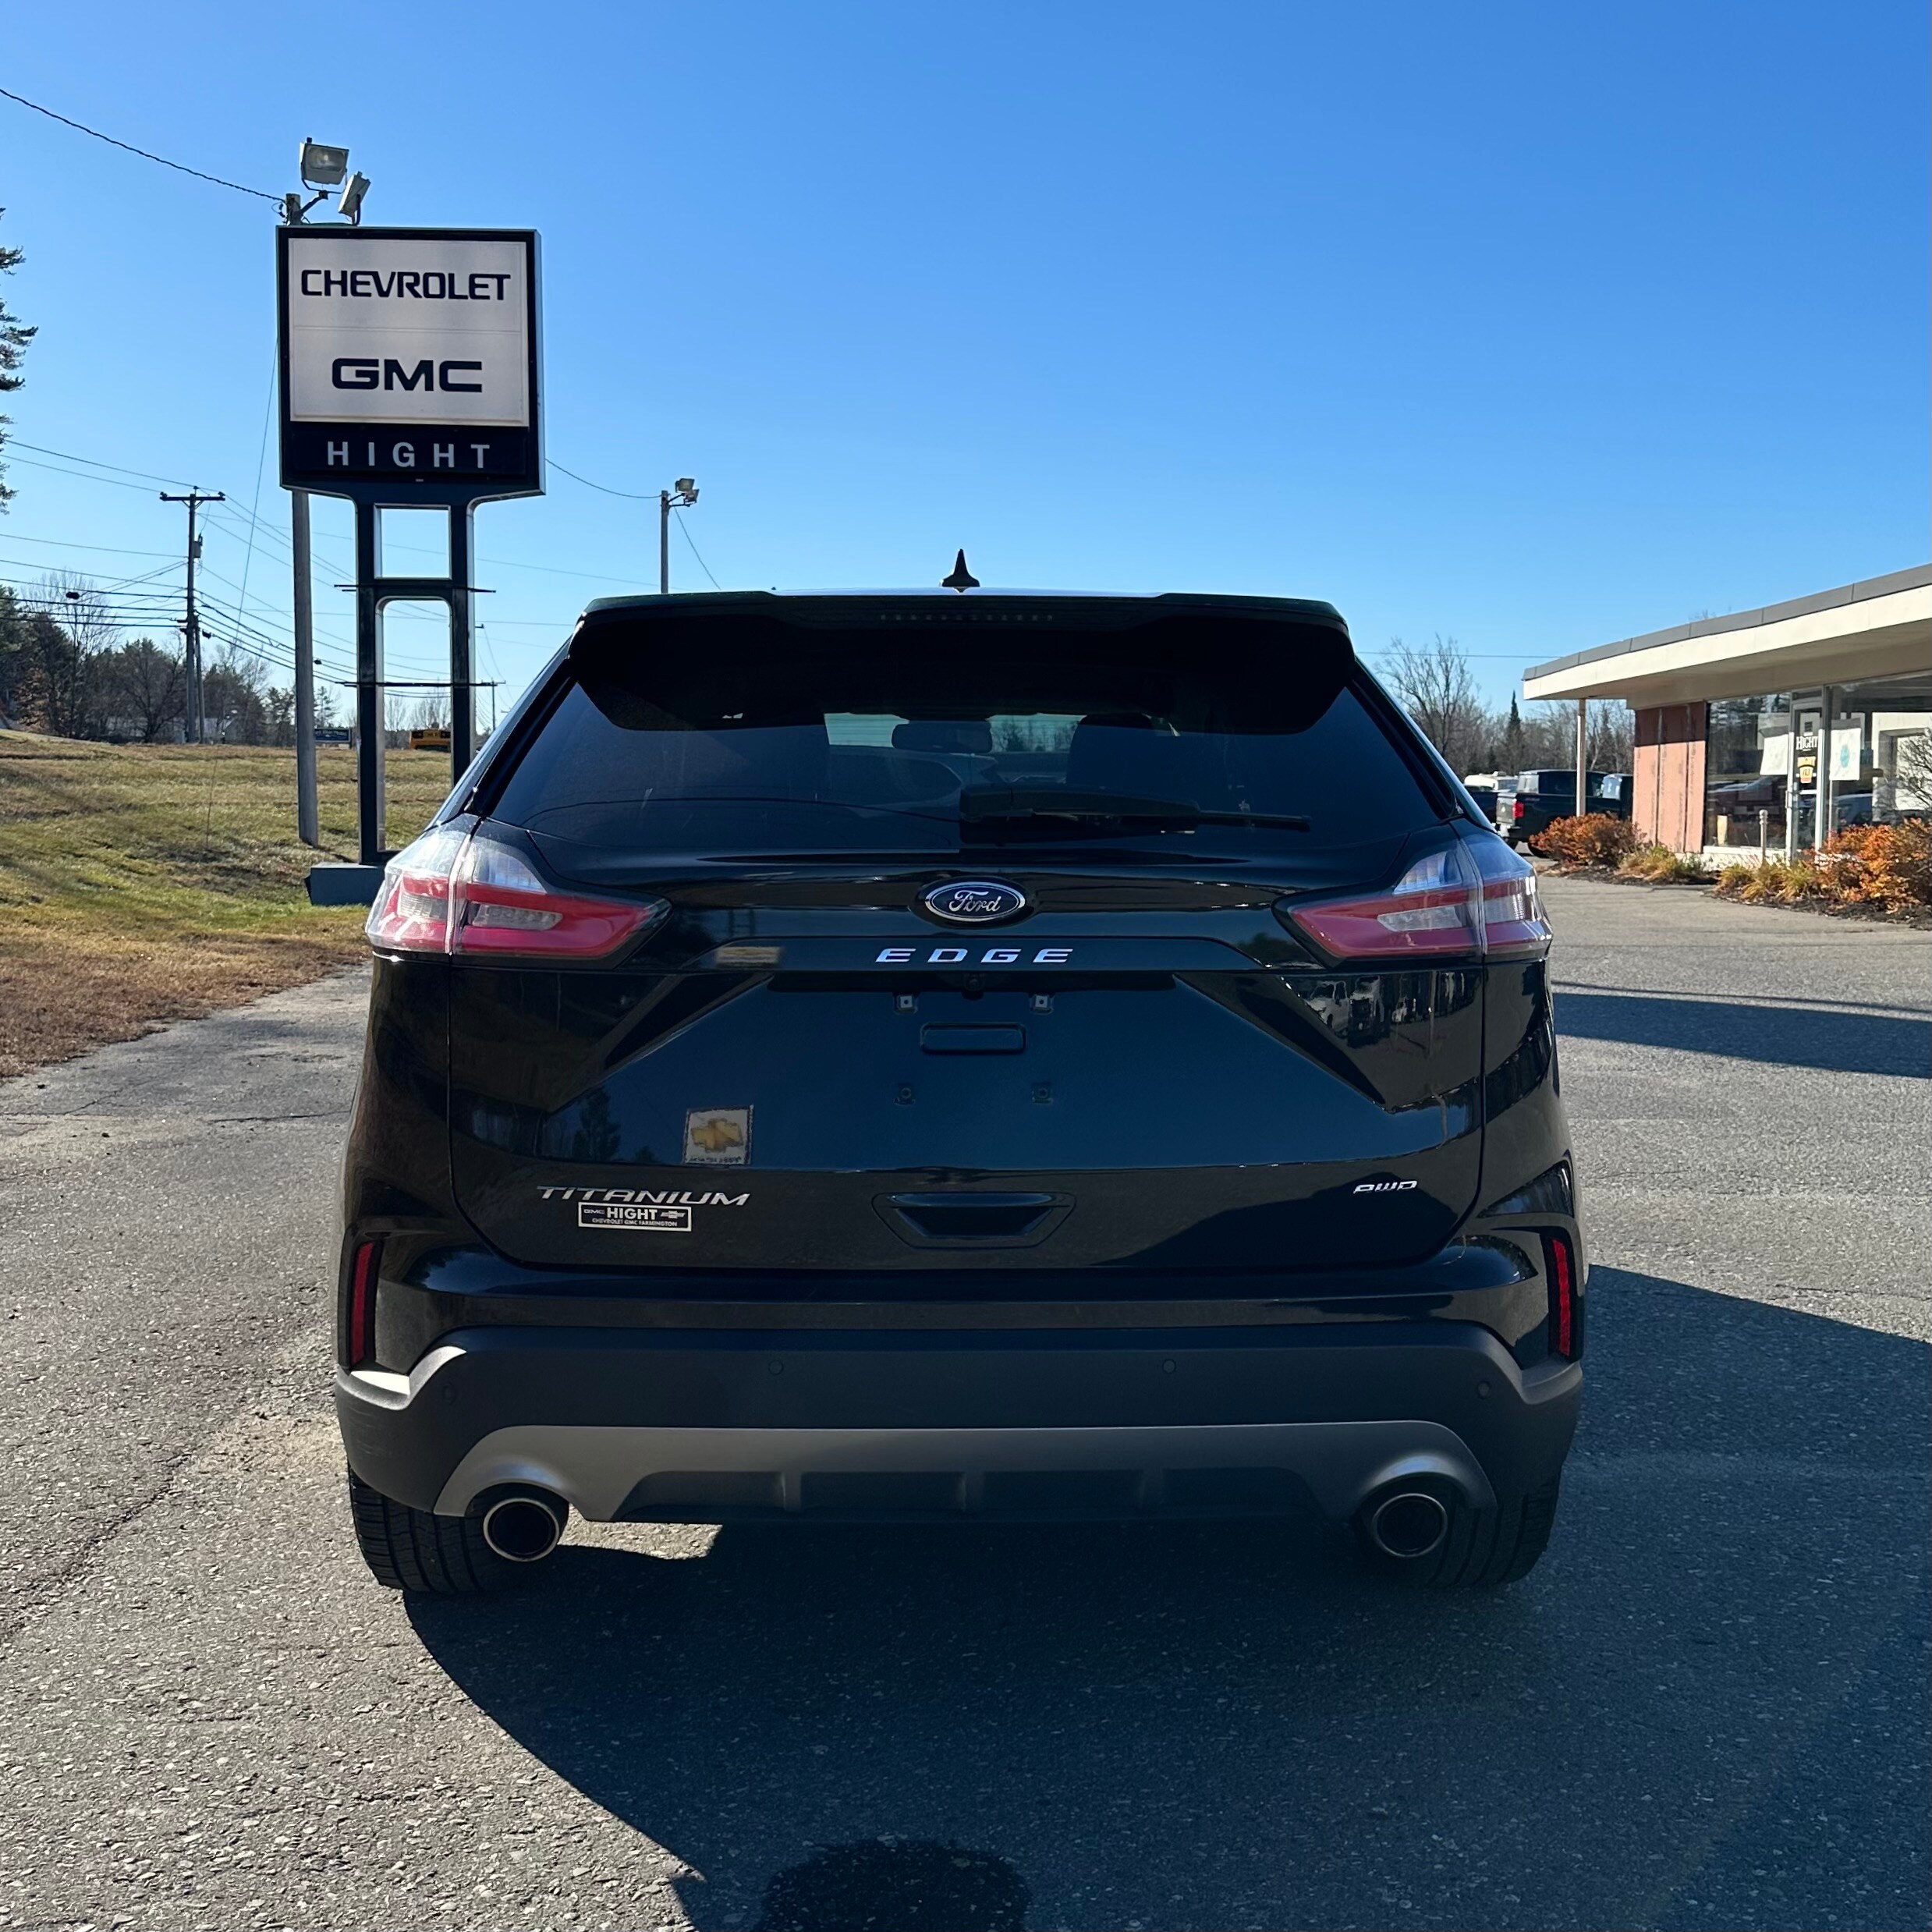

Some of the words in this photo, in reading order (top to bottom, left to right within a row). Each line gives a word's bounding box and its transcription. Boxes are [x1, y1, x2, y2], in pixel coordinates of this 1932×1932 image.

[301, 269, 511, 301] CHEVROLET
[331, 357, 483, 393] GMC
[327, 441, 491, 469] HIGHT
[1796, 736, 1818, 750] HIGHT
[948, 890, 1001, 913] Ford
[875, 948, 1073, 963] EDGE
[537, 1186, 750, 1206] TITANIUM
[1352, 1180, 1417, 1194] AWD
[607, 1207, 658, 1220] HIGHT
